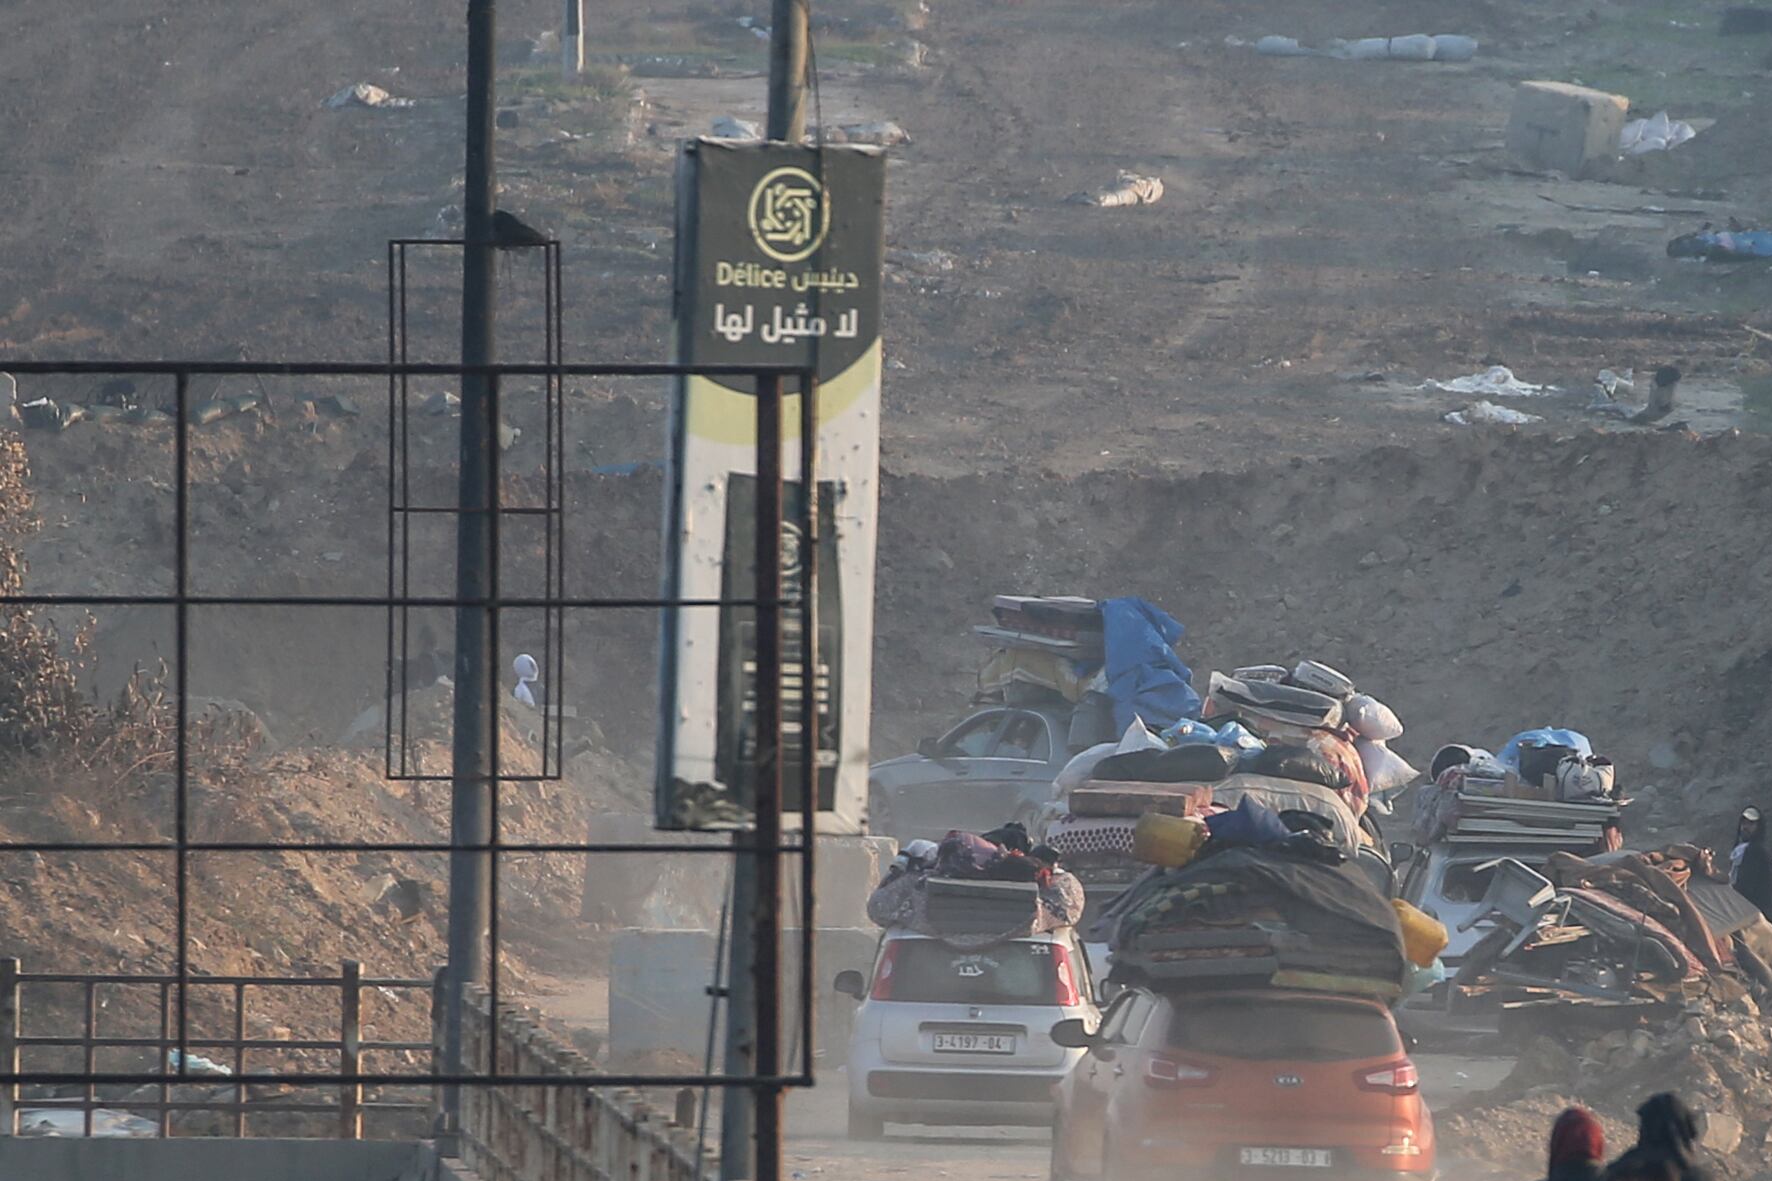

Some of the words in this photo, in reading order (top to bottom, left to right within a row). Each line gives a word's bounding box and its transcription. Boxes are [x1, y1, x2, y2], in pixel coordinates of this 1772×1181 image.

[715, 261, 787, 289] Délice
[714, 302, 754, 342] لها
[760, 302, 828, 344] مثيل
[833, 307, 859, 338] لا
